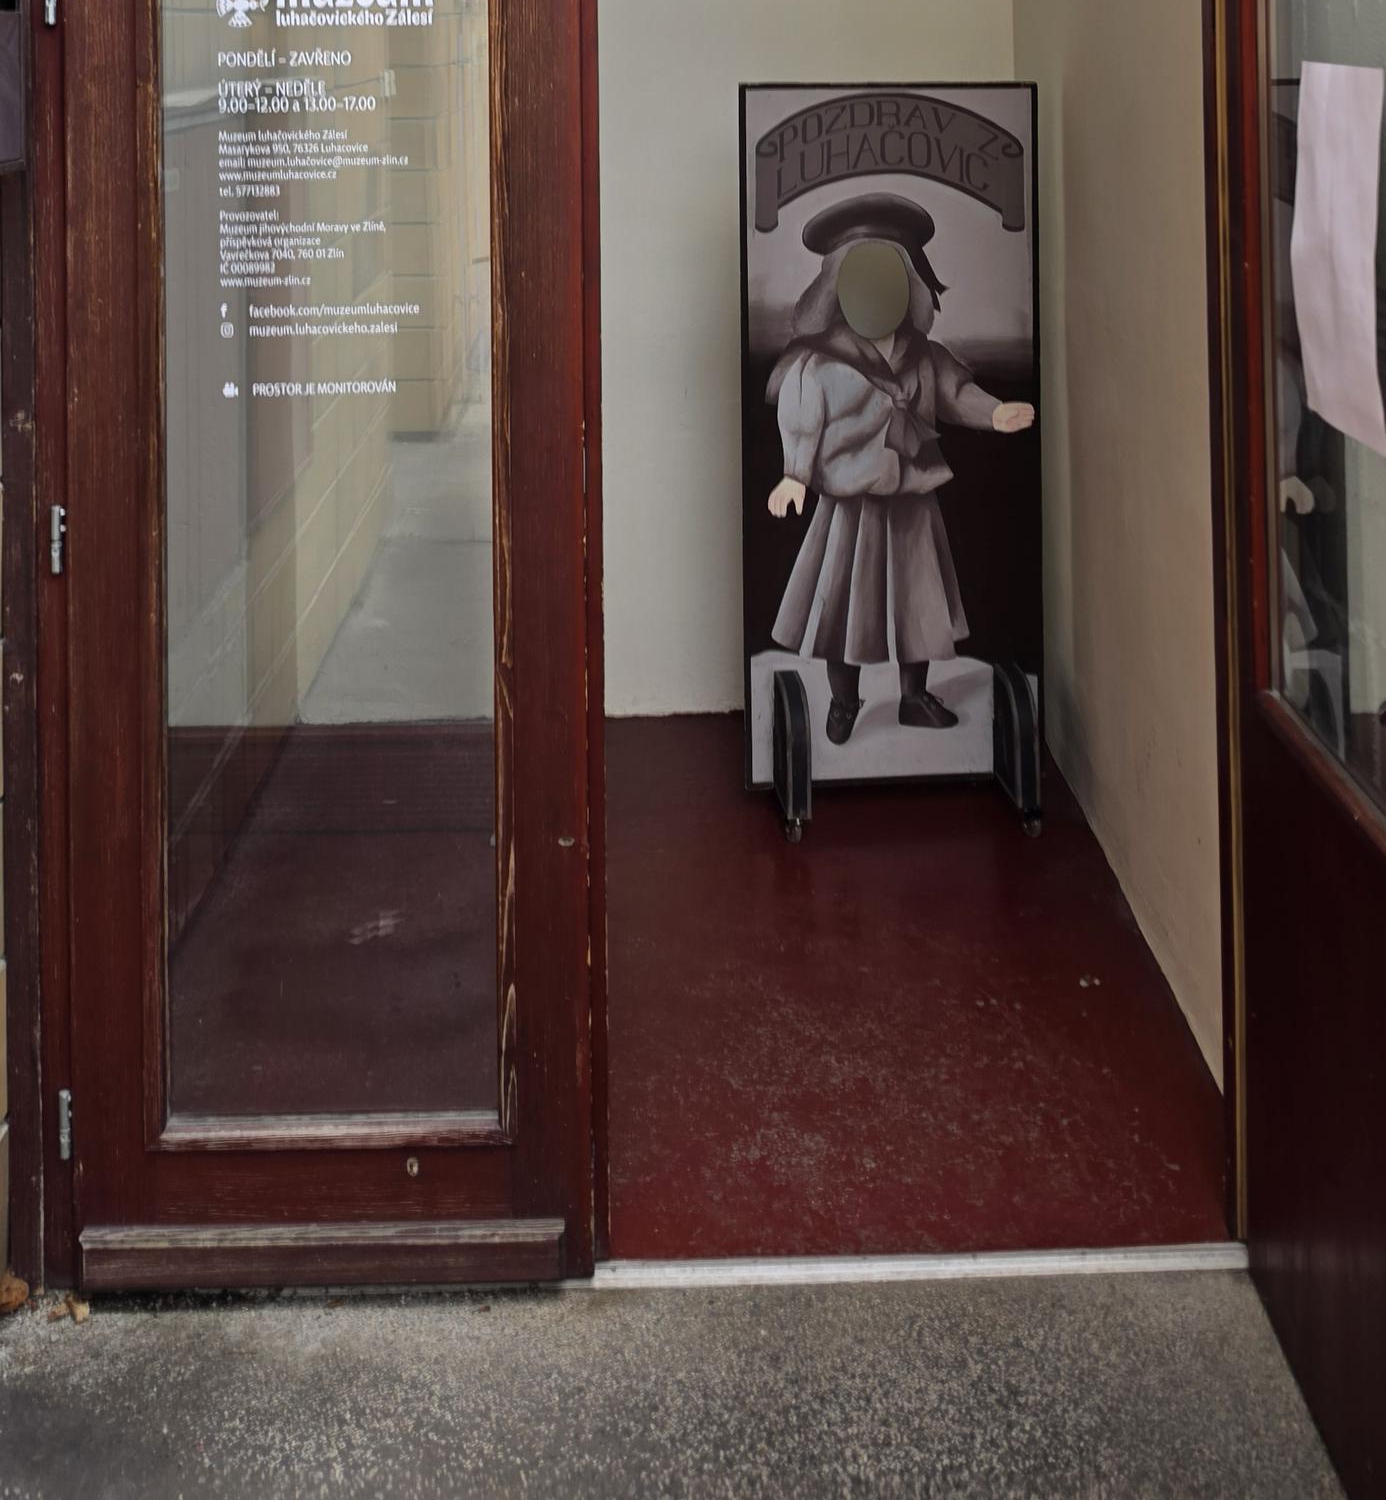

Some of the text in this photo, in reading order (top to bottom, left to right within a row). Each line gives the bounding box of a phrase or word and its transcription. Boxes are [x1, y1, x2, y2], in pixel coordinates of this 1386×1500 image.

[276, 8, 434, 27] luhačovického Zálesí
[218, 47, 276, 67] PONDĚLÍ
[289, 47, 352, 67] ZAVŘENO
[218, 78, 262, 98] ÚTERÝ
[276, 78, 327, 97] NEDĚLE
[292, 100, 301, 113] a
[218, 129, 348, 142] Muzeum luhačovického Zálesí
[779, 100, 998, 163] POZDRAV Z
[218, 143, 271, 157] Masarykova
[272, 143, 291, 155] 950,
[293, 143, 319, 153] 76326
[218, 156, 246, 168] email:
[776, 124, 989, 200] LUHAČOVIC
[218, 170, 337, 182] www.muzeumluhacovice.cz
[219, 184, 280, 197] tel. 577132883
[219, 209, 280, 222] Provozovatel:
[219, 220, 386, 236] Muzeum jihovýchodní Moravy ve Zlíně,
[220, 235, 321, 249] příspěvková organizace
[271, 248, 295, 260] 7040,
[297, 248, 314, 258] 760
[315, 248, 326, 258] 01
[220, 260, 229, 275] IČ
[219, 274, 311, 287] www.muzeum-zlin.cz
[249, 302, 420, 318] facebook.com/muzeumluhacovice
[249, 321, 398, 337] muzeum.luhacovickeho.zalesi
[252, 378, 397, 398] PROSTOR JE MONITOROVÁN
